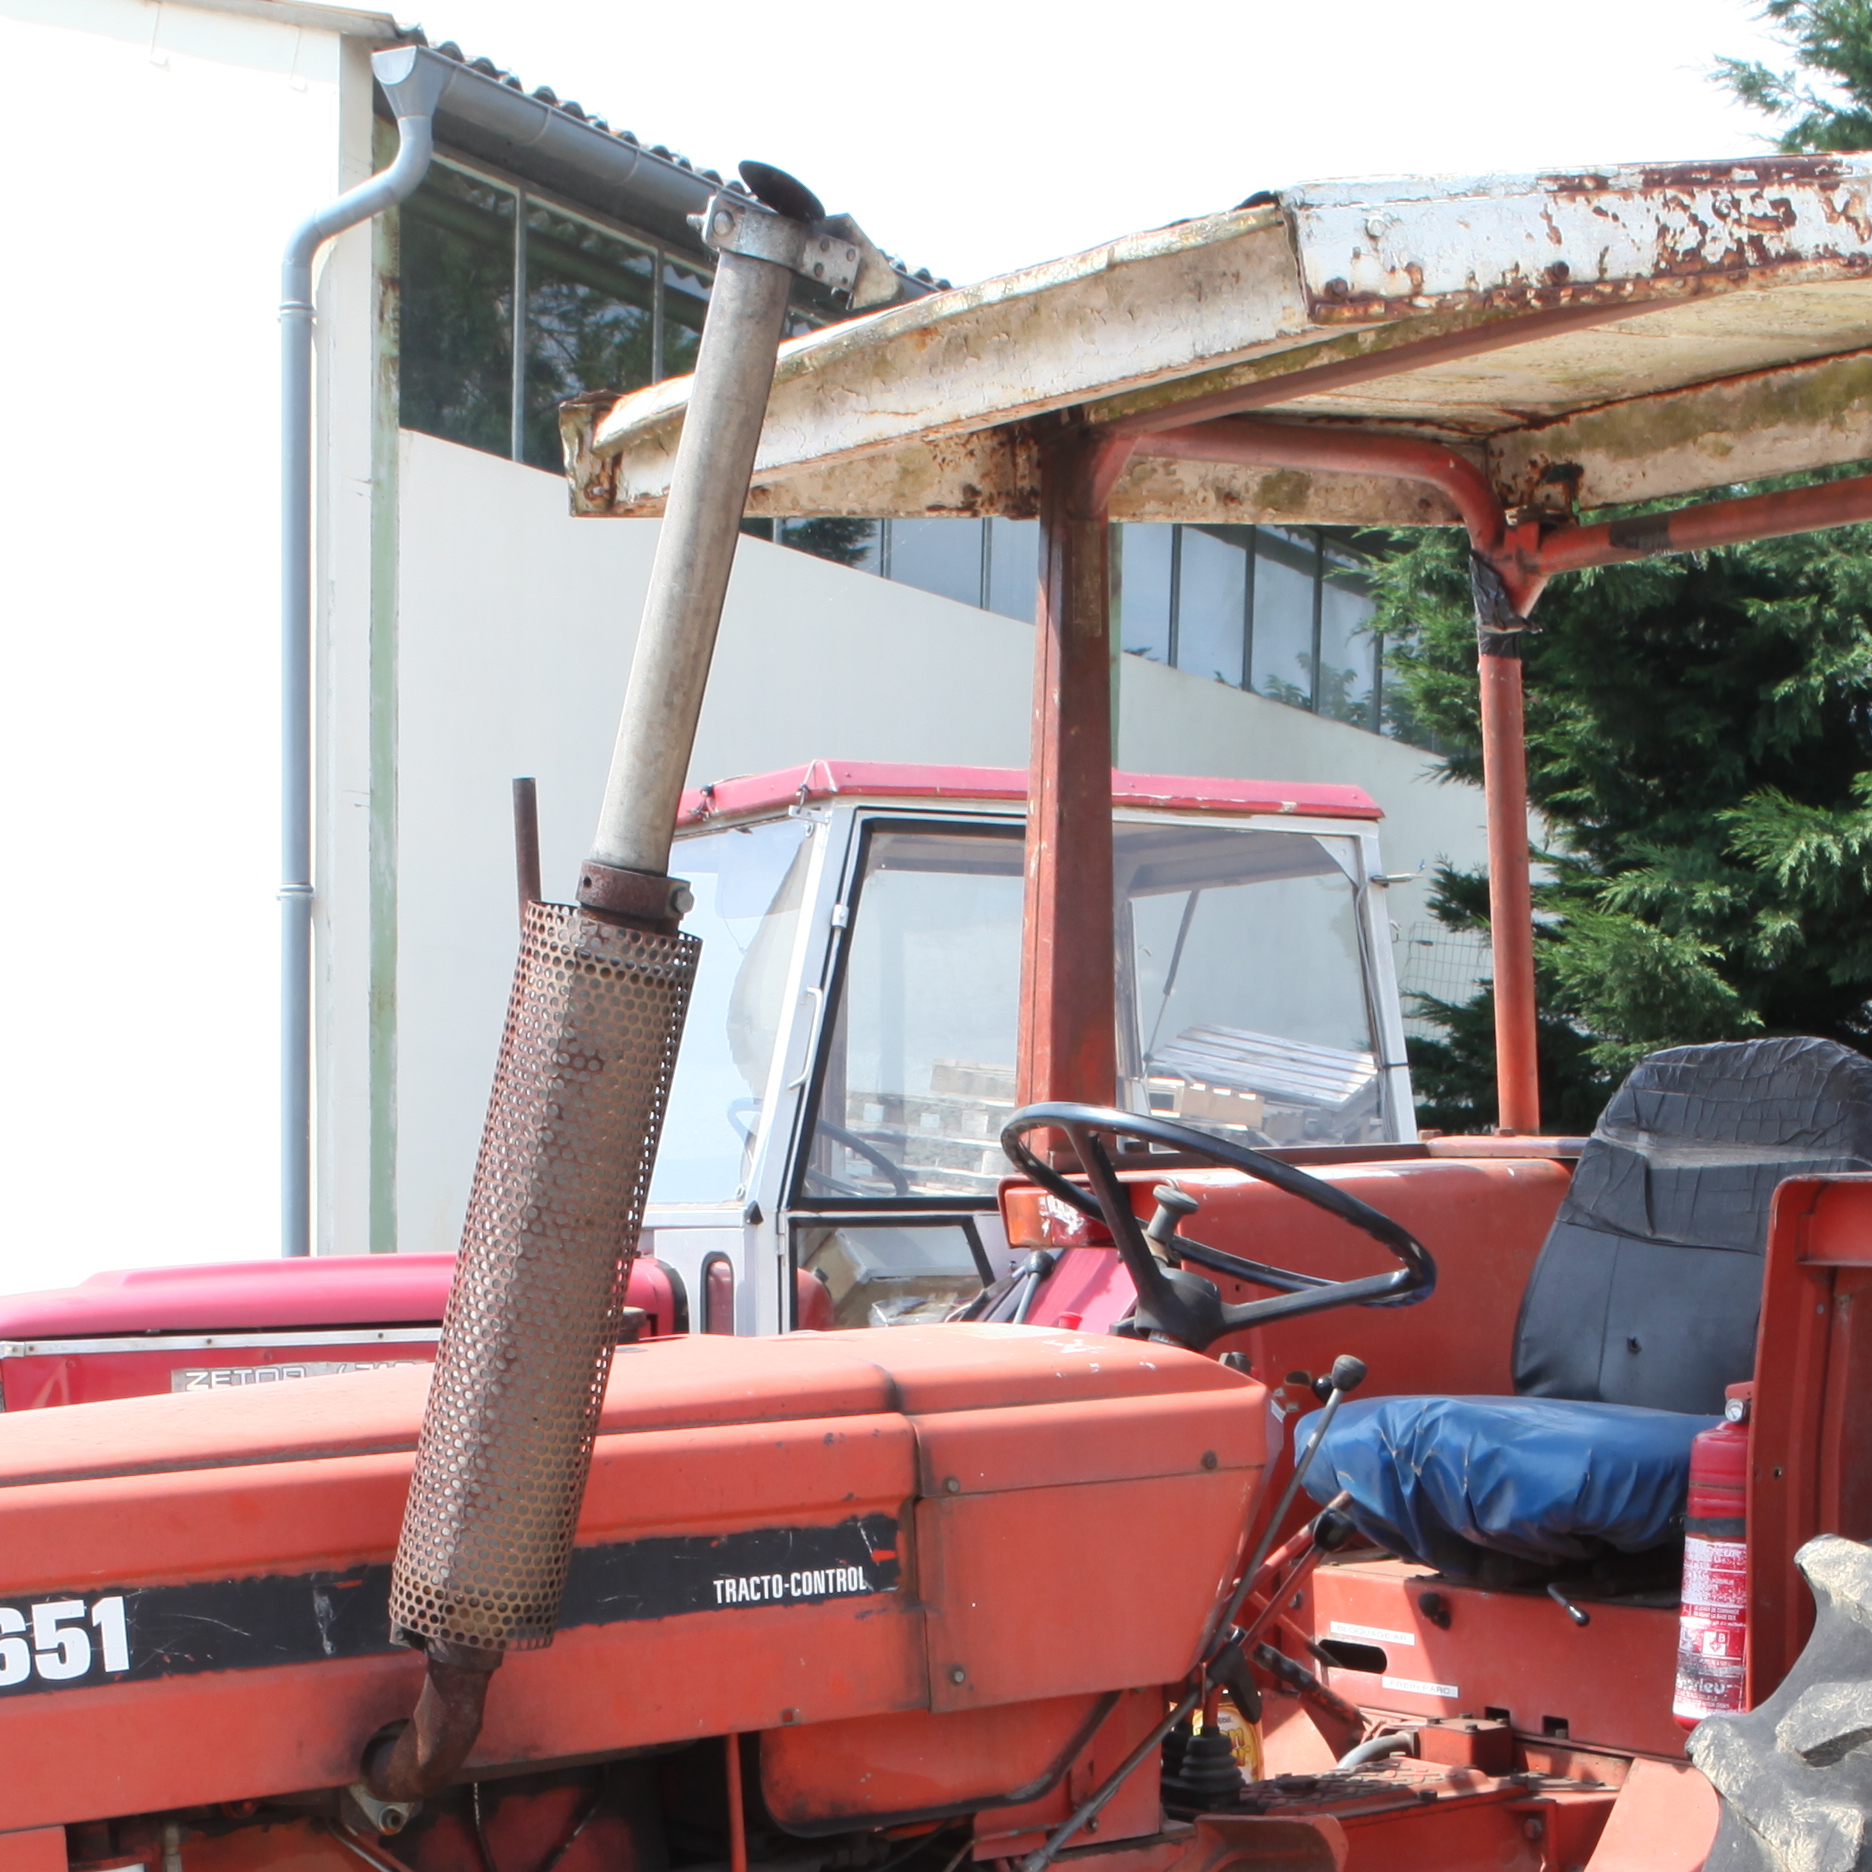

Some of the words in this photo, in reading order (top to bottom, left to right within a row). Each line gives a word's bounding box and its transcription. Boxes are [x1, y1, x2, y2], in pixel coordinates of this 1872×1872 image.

[713, 1566, 868, 1604] TRACTO-CONTROL
[1337, 1625, 1390, 1639] BLOQUAGE
[1390, 1680, 1419, 1691] FREIN
